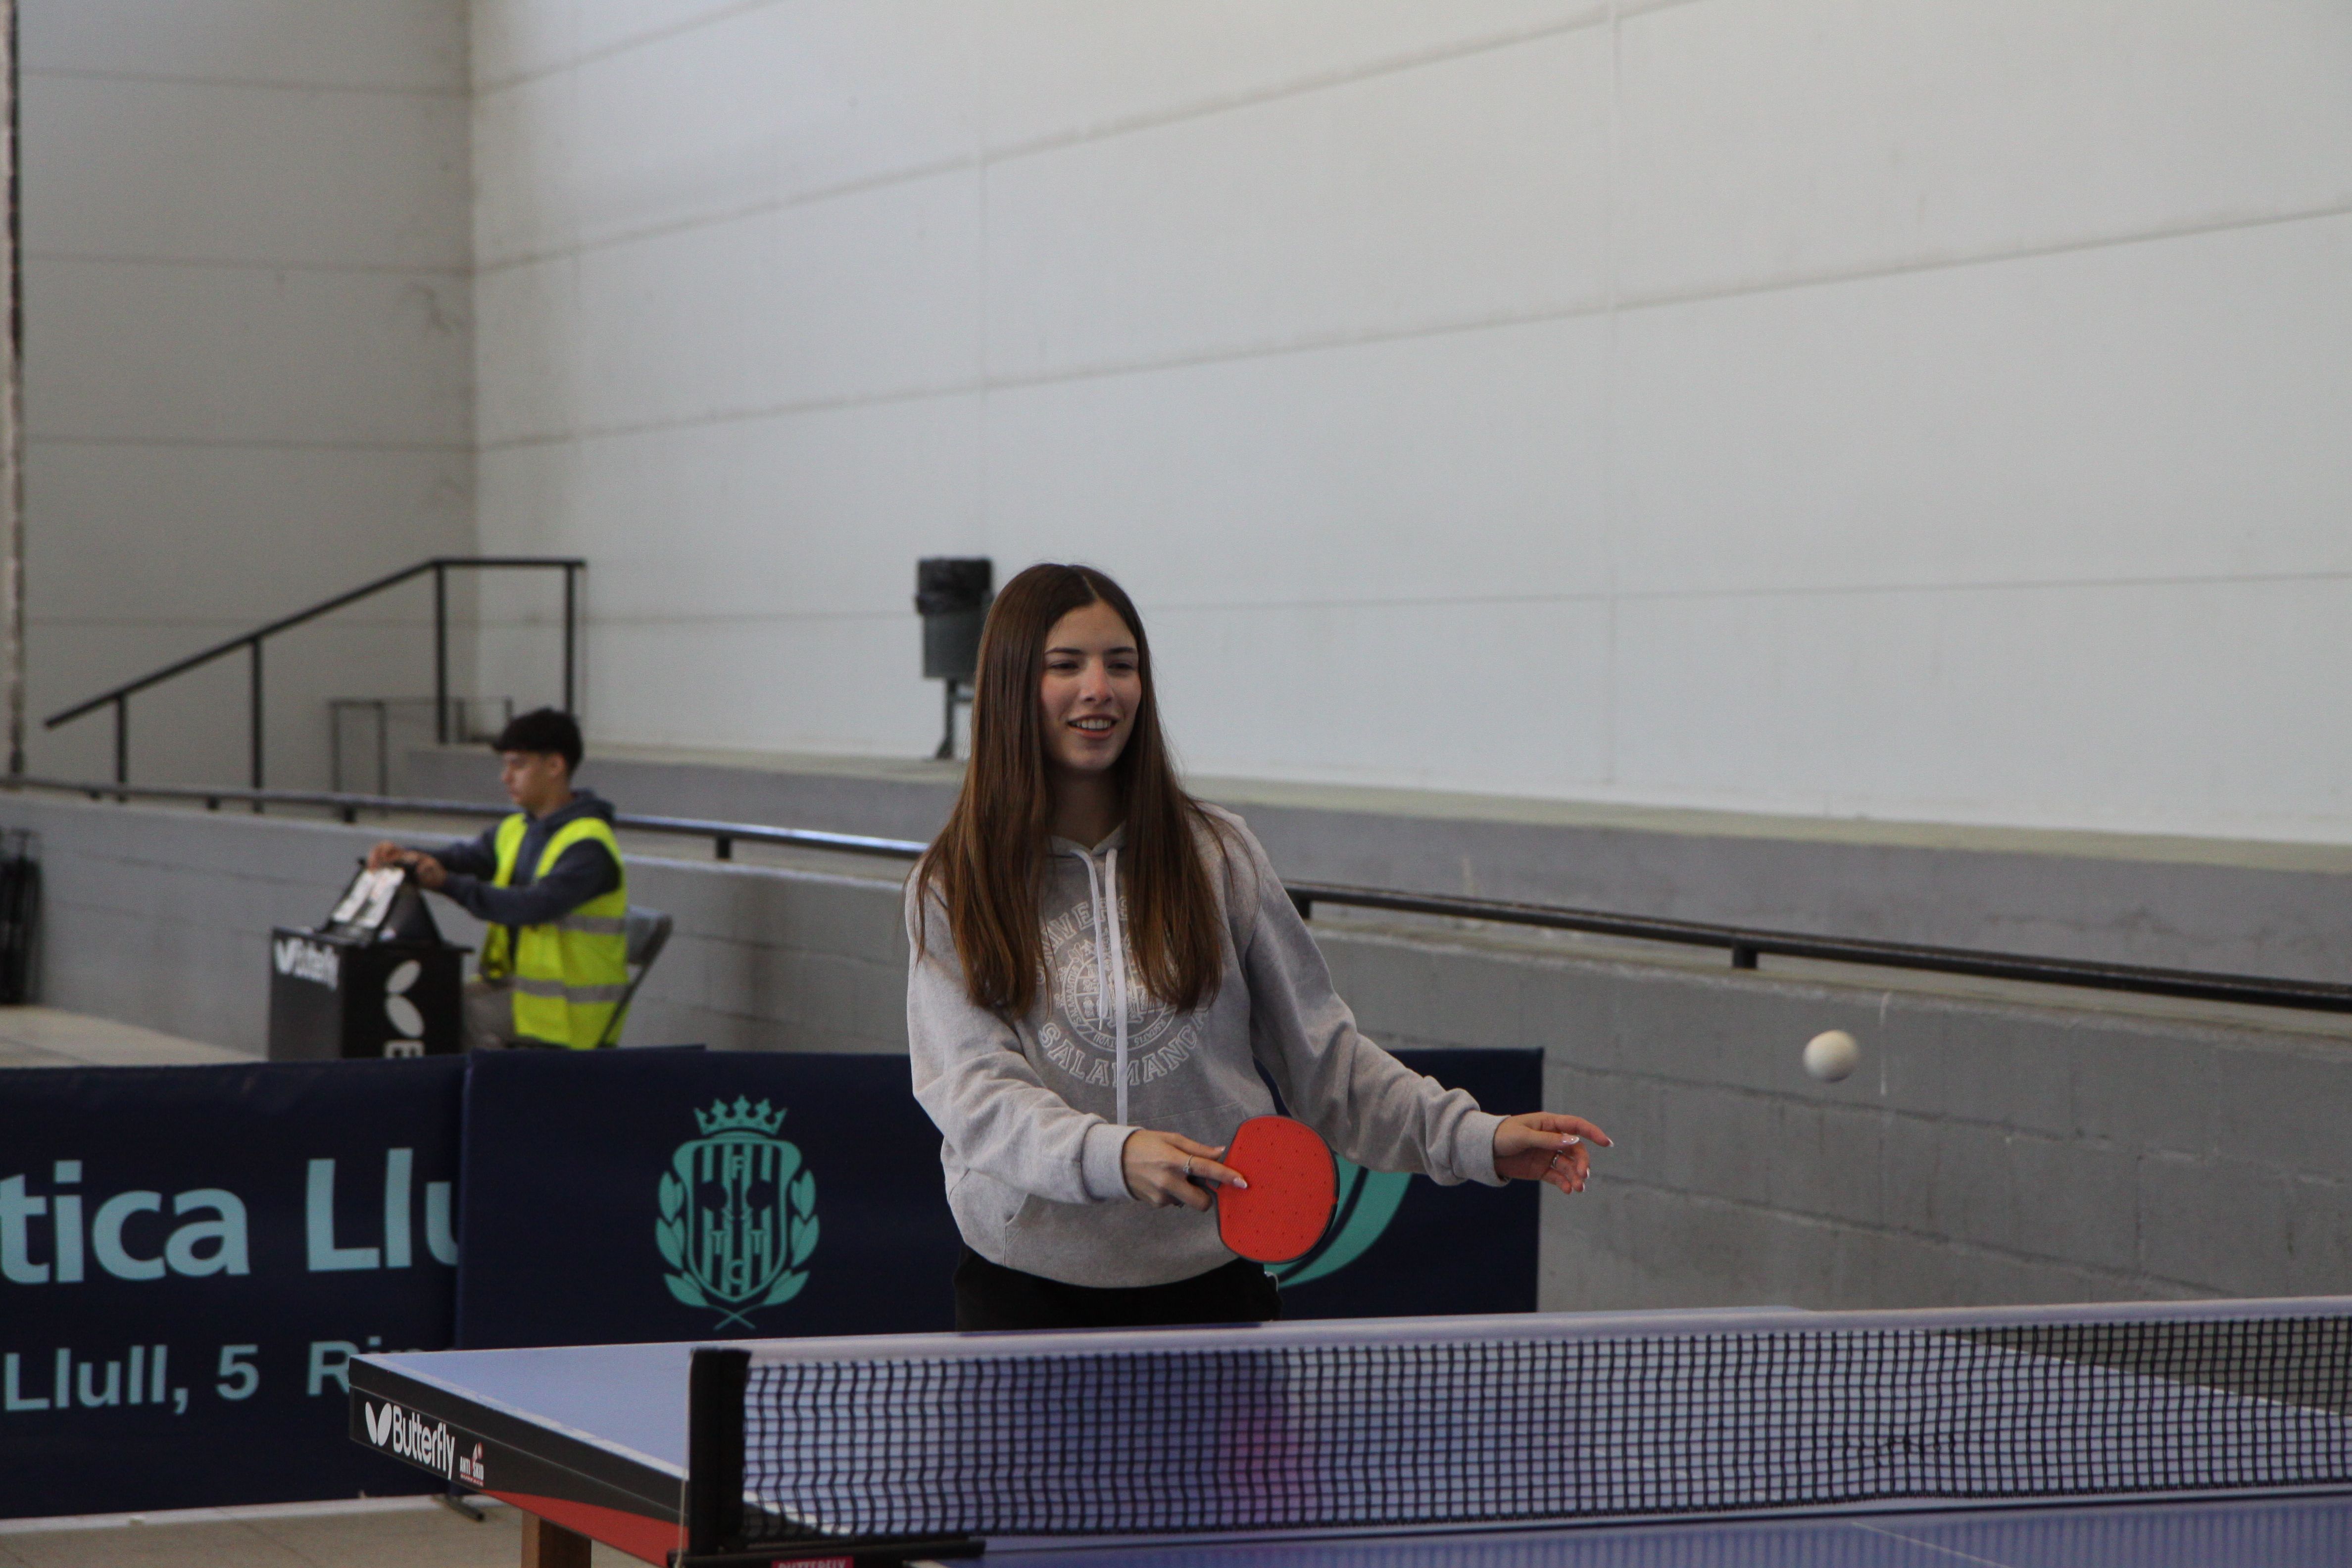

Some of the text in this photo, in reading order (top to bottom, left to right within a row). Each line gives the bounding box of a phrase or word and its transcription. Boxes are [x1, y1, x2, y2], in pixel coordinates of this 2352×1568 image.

[4, 1345, 188, 1416] Llull,
[216, 1344, 259, 1400] 5
[393, 1405, 455, 1481] Butterfly
